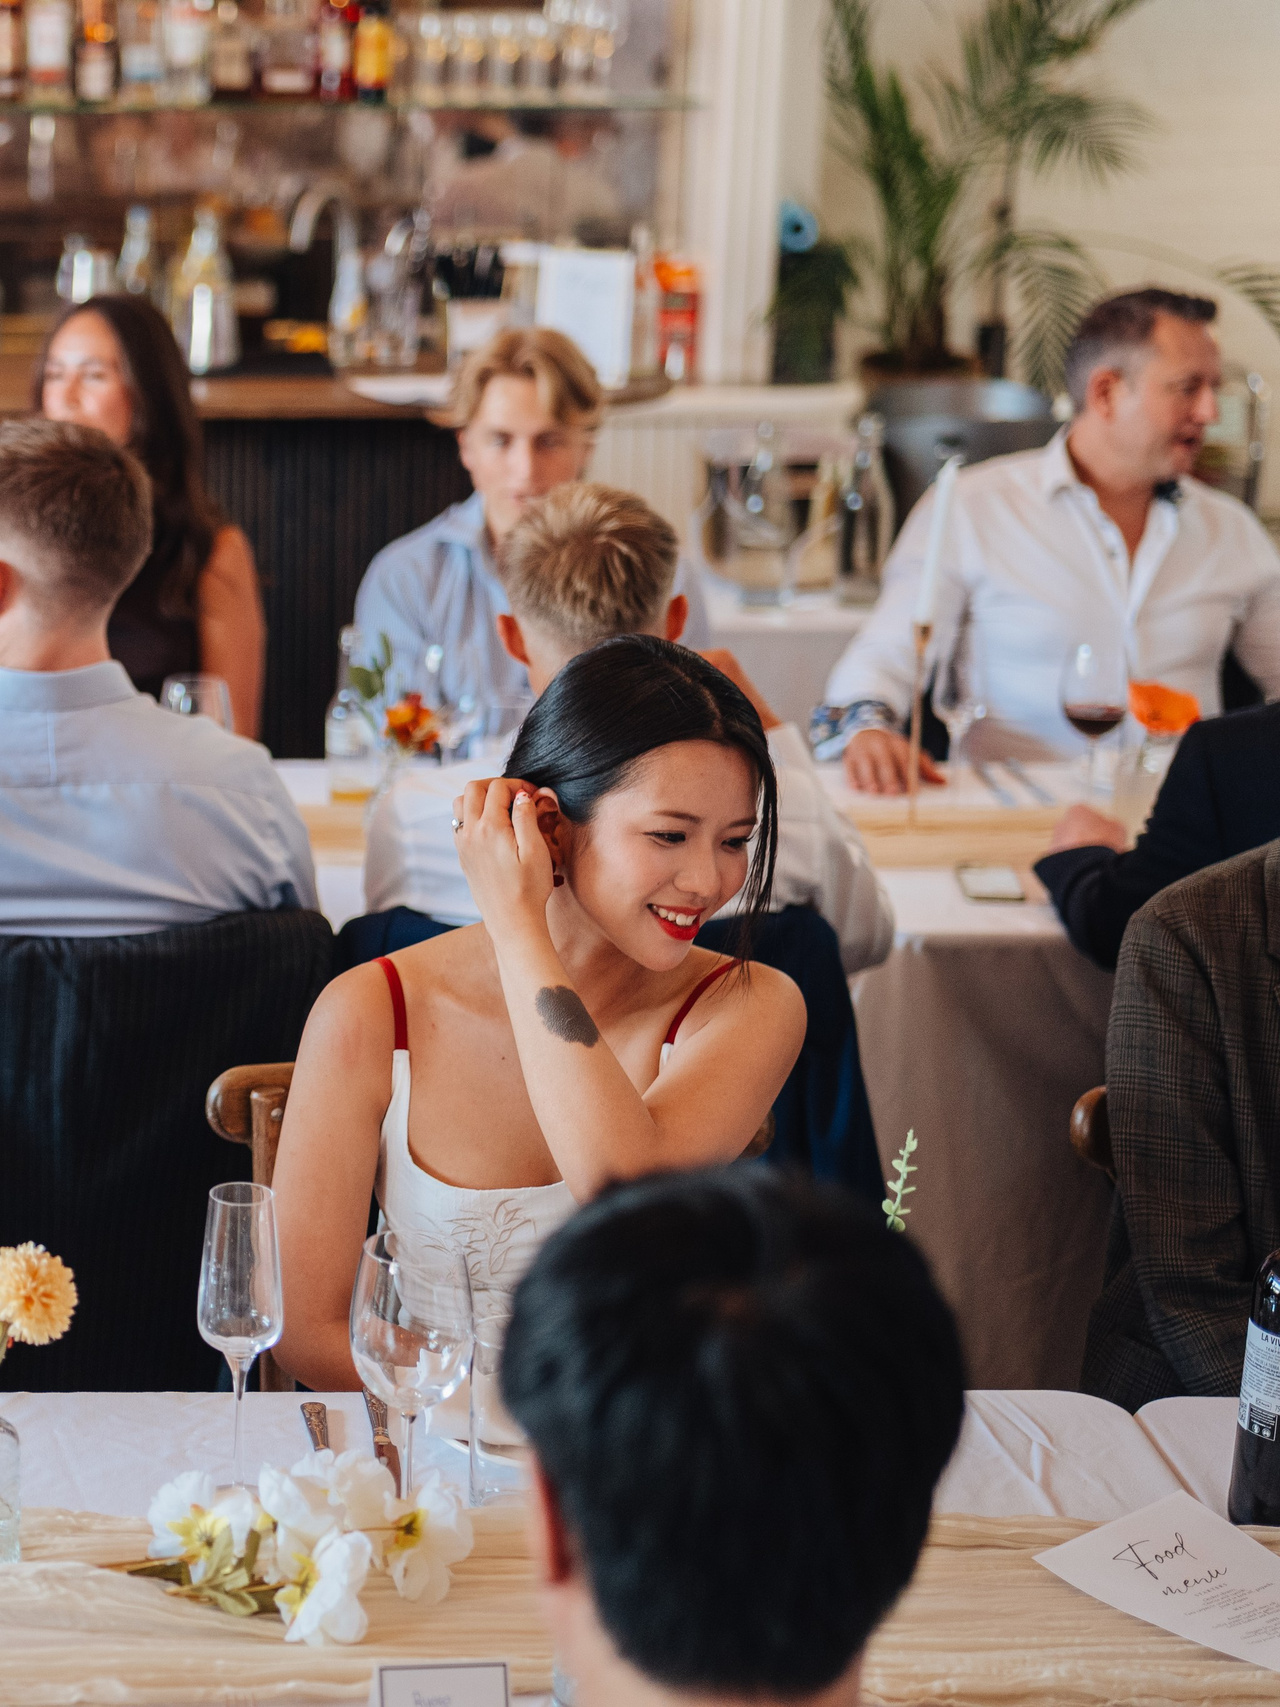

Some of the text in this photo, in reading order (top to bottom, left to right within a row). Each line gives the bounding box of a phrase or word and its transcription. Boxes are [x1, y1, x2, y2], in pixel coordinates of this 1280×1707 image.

[1261, 1332, 1269, 1343] LA
[1112, 1532, 1198, 1580] Food
[1162, 1567, 1228, 1596] menu
